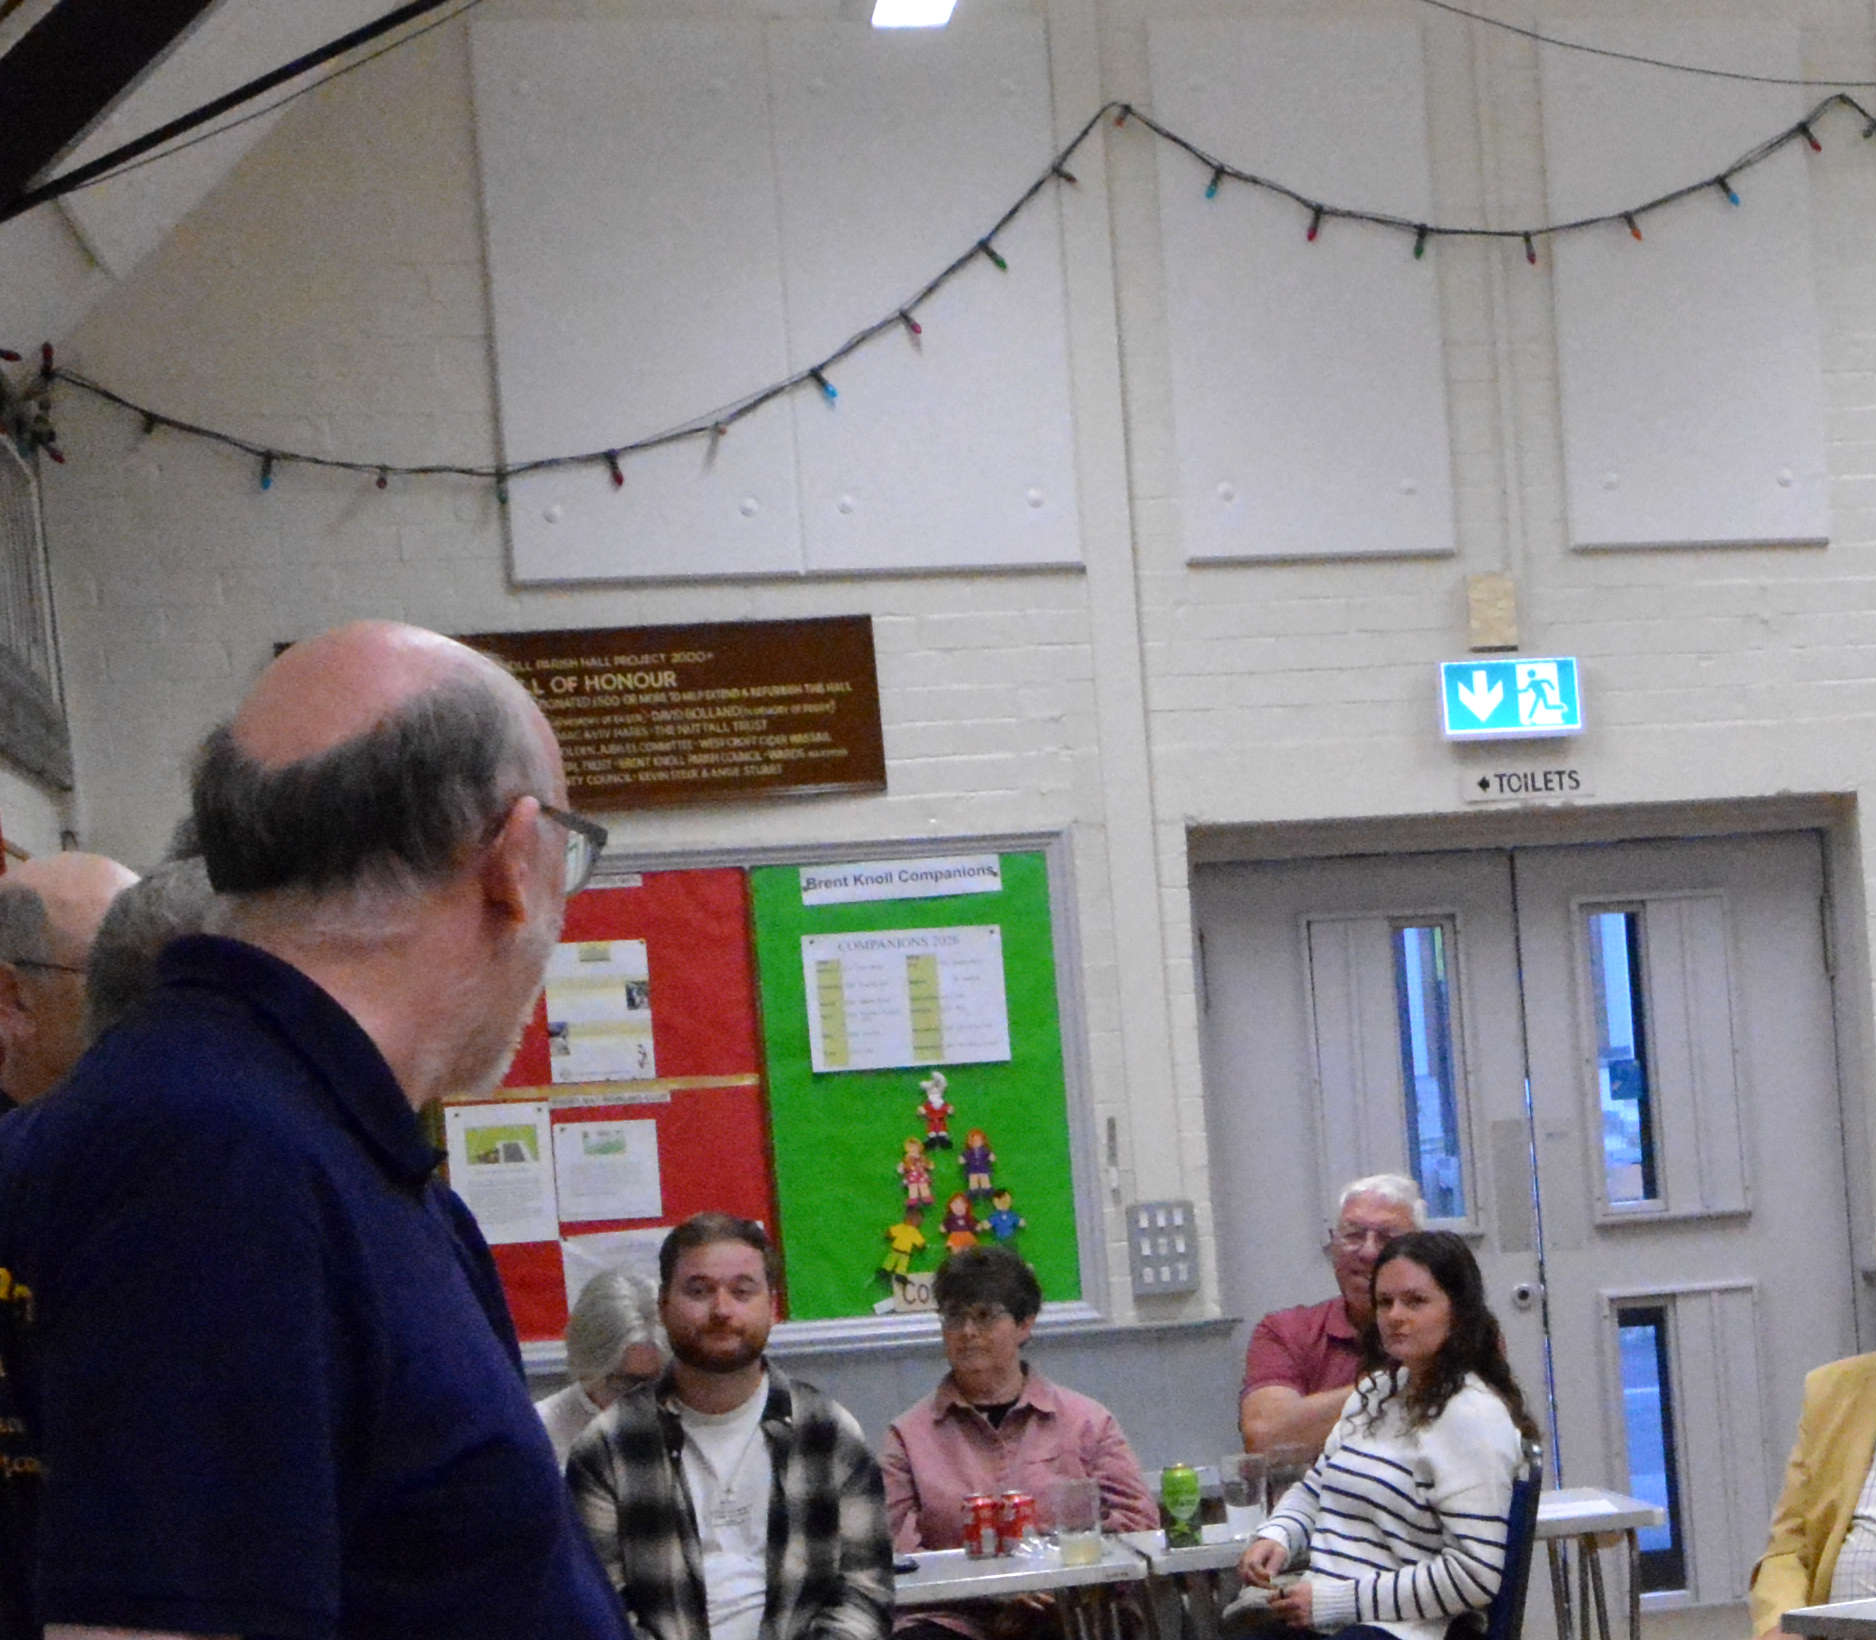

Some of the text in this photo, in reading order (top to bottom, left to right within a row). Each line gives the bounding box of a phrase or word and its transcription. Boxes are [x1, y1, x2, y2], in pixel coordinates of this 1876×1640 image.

[580, 656, 611, 668] HALL
[614, 653, 666, 666] PROJECT
[550, 675, 579, 694] OF
[584, 670, 678, 692] HONOUR
[1494, 770, 1581, 793] TOILETS
[806, 864, 994, 890] Brent Knoll Companions
[837, 935, 930, 952] COMPANIONS
